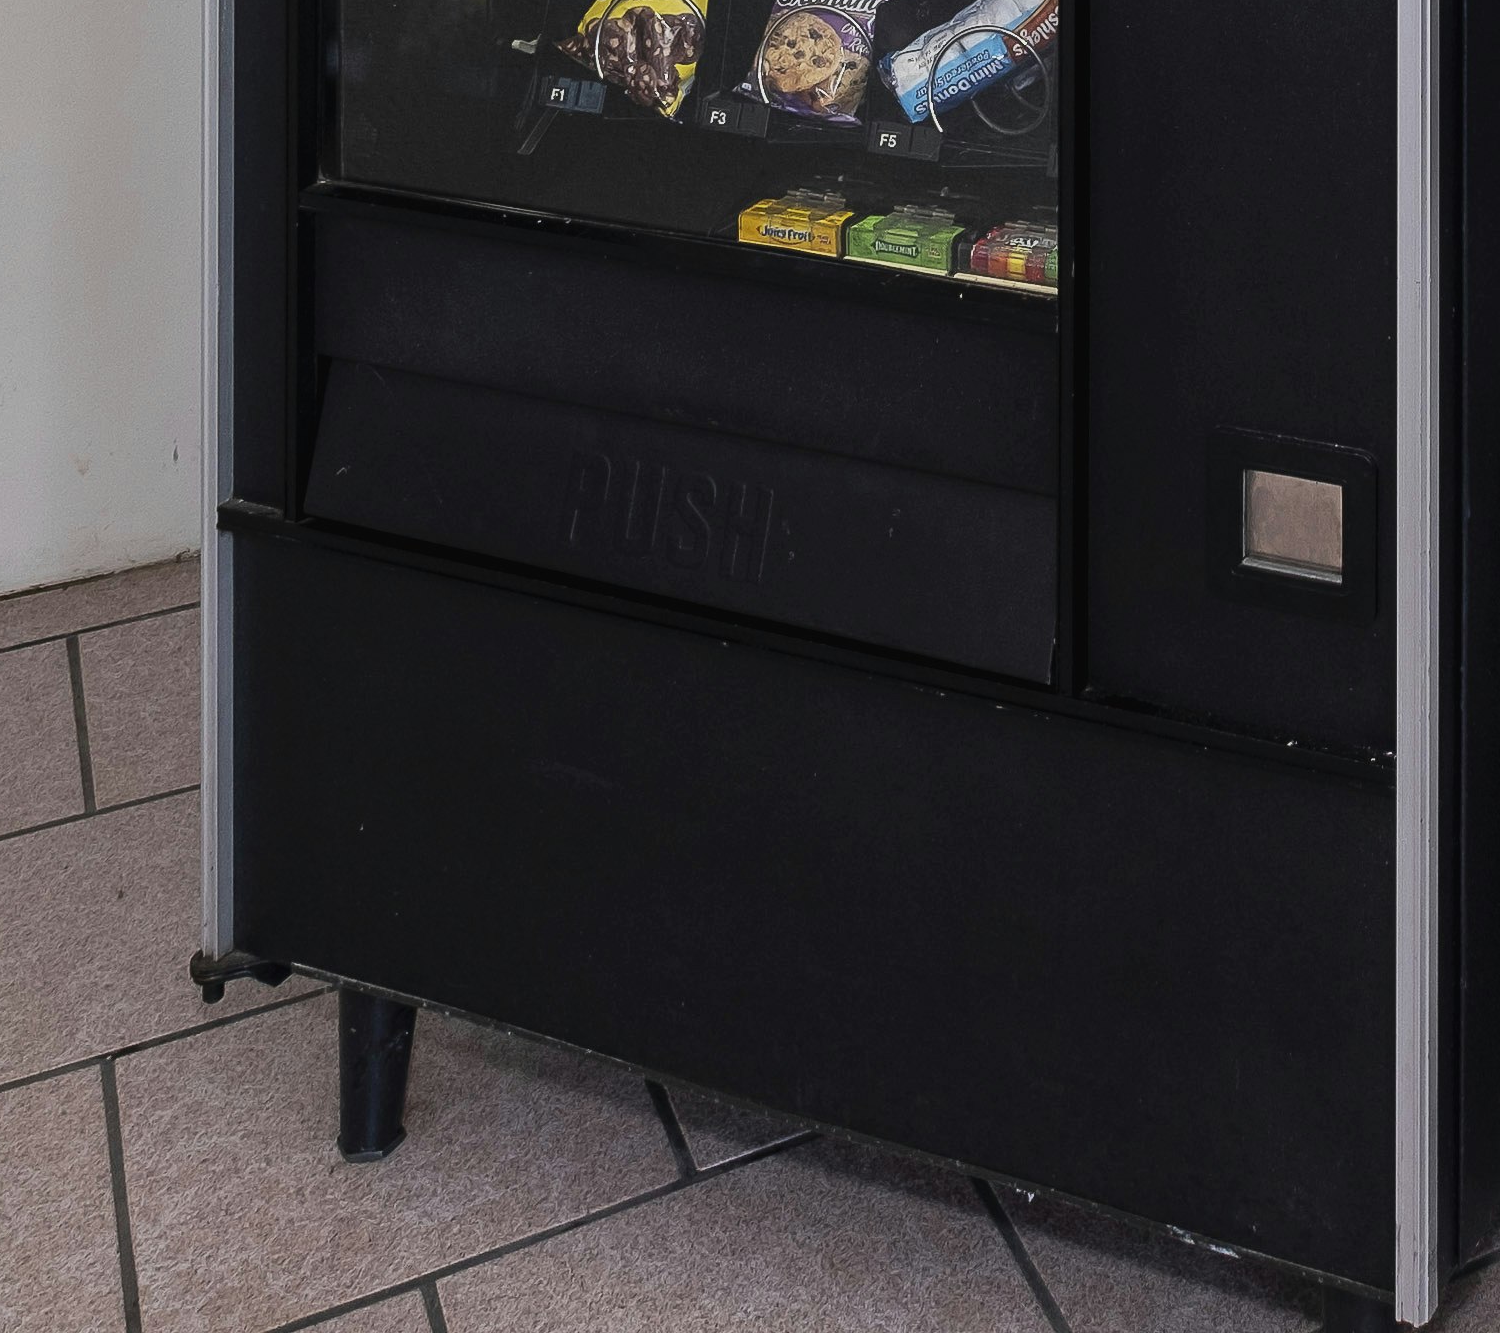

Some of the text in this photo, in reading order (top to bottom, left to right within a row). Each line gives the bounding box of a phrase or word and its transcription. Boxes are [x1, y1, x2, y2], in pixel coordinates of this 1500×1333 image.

[945, 48, 992, 83] Powdered
[969, 57, 1006, 85] Mini
[550, 88, 565, 102] F1
[709, 110, 727, 125] F3
[880, 133, 897, 148] F5
[761, 224, 816, 243] Juicy Fruit
[874, 239, 920, 257] DOUBLEMINT
[568, 449, 776, 584] PUSH
